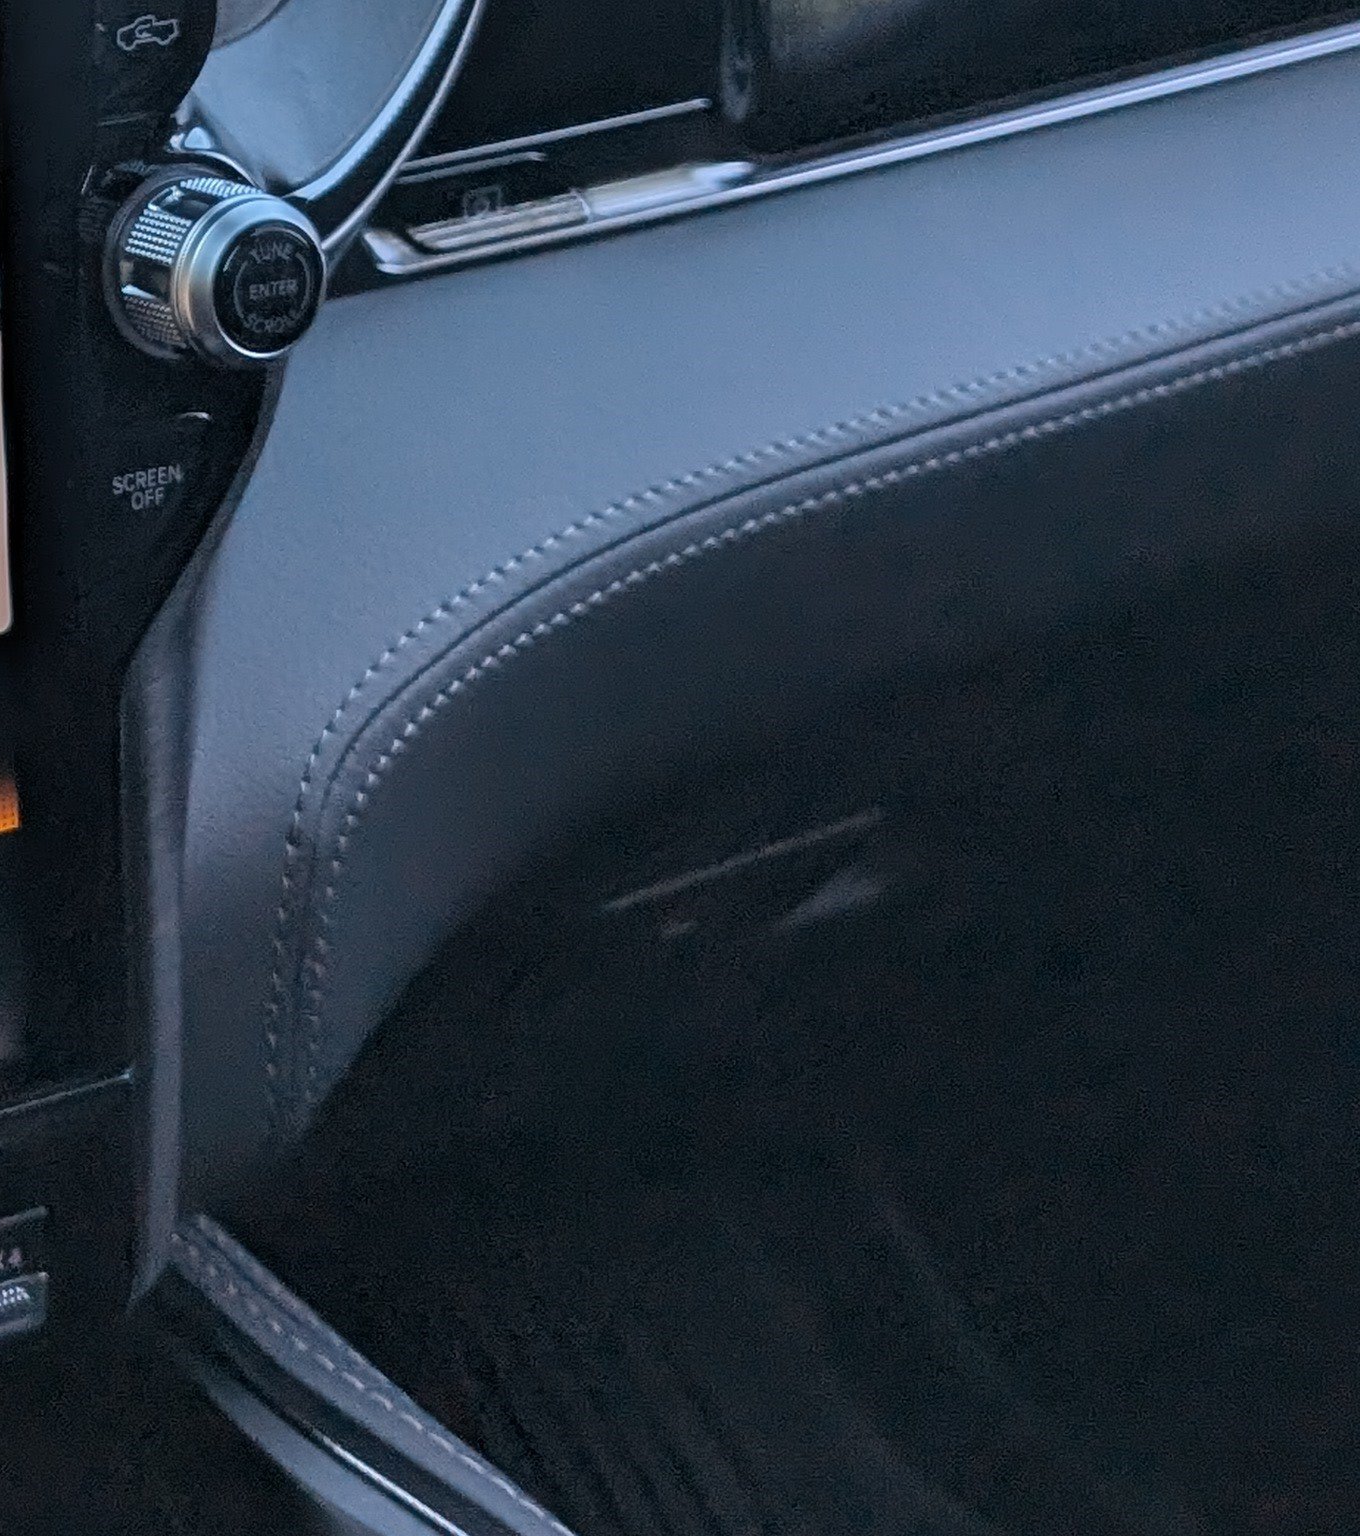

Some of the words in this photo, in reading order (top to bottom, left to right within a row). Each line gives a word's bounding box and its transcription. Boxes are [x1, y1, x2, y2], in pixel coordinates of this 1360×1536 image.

[249, 279, 298, 301] ENTER
[112, 464, 182, 495] SCREEN
[131, 484, 166, 511] OFF
